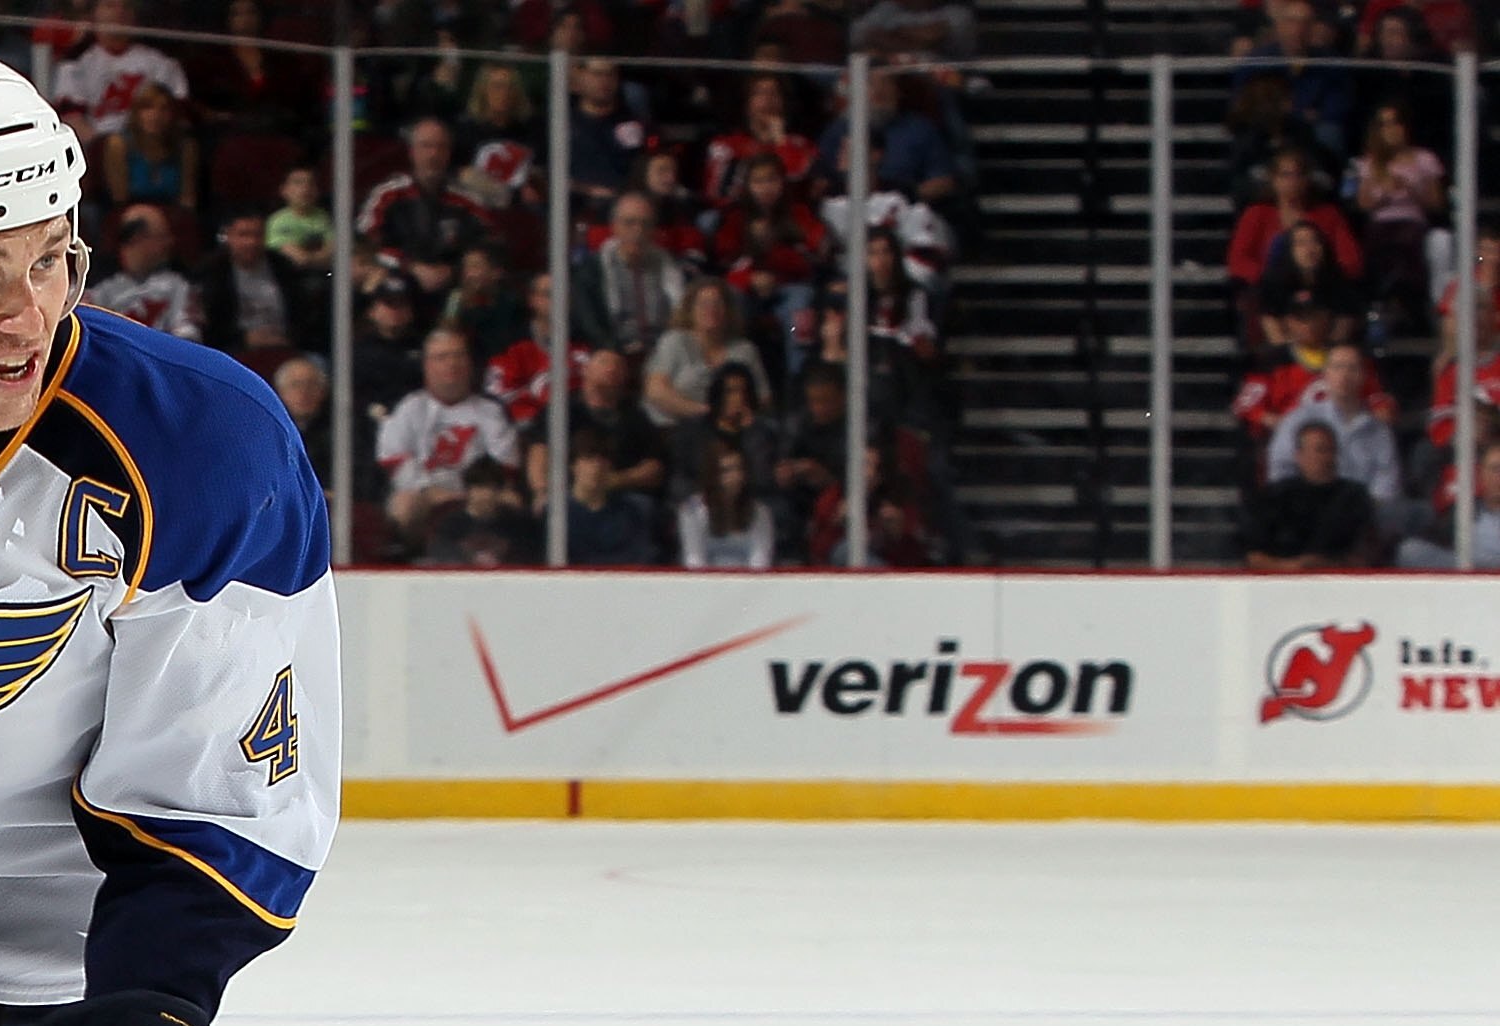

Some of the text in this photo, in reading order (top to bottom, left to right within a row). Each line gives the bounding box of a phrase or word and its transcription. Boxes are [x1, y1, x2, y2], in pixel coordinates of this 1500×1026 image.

[57, 476, 131, 577] C
[239, 663, 299, 787] 4
[769, 638, 1132, 734] verizon
